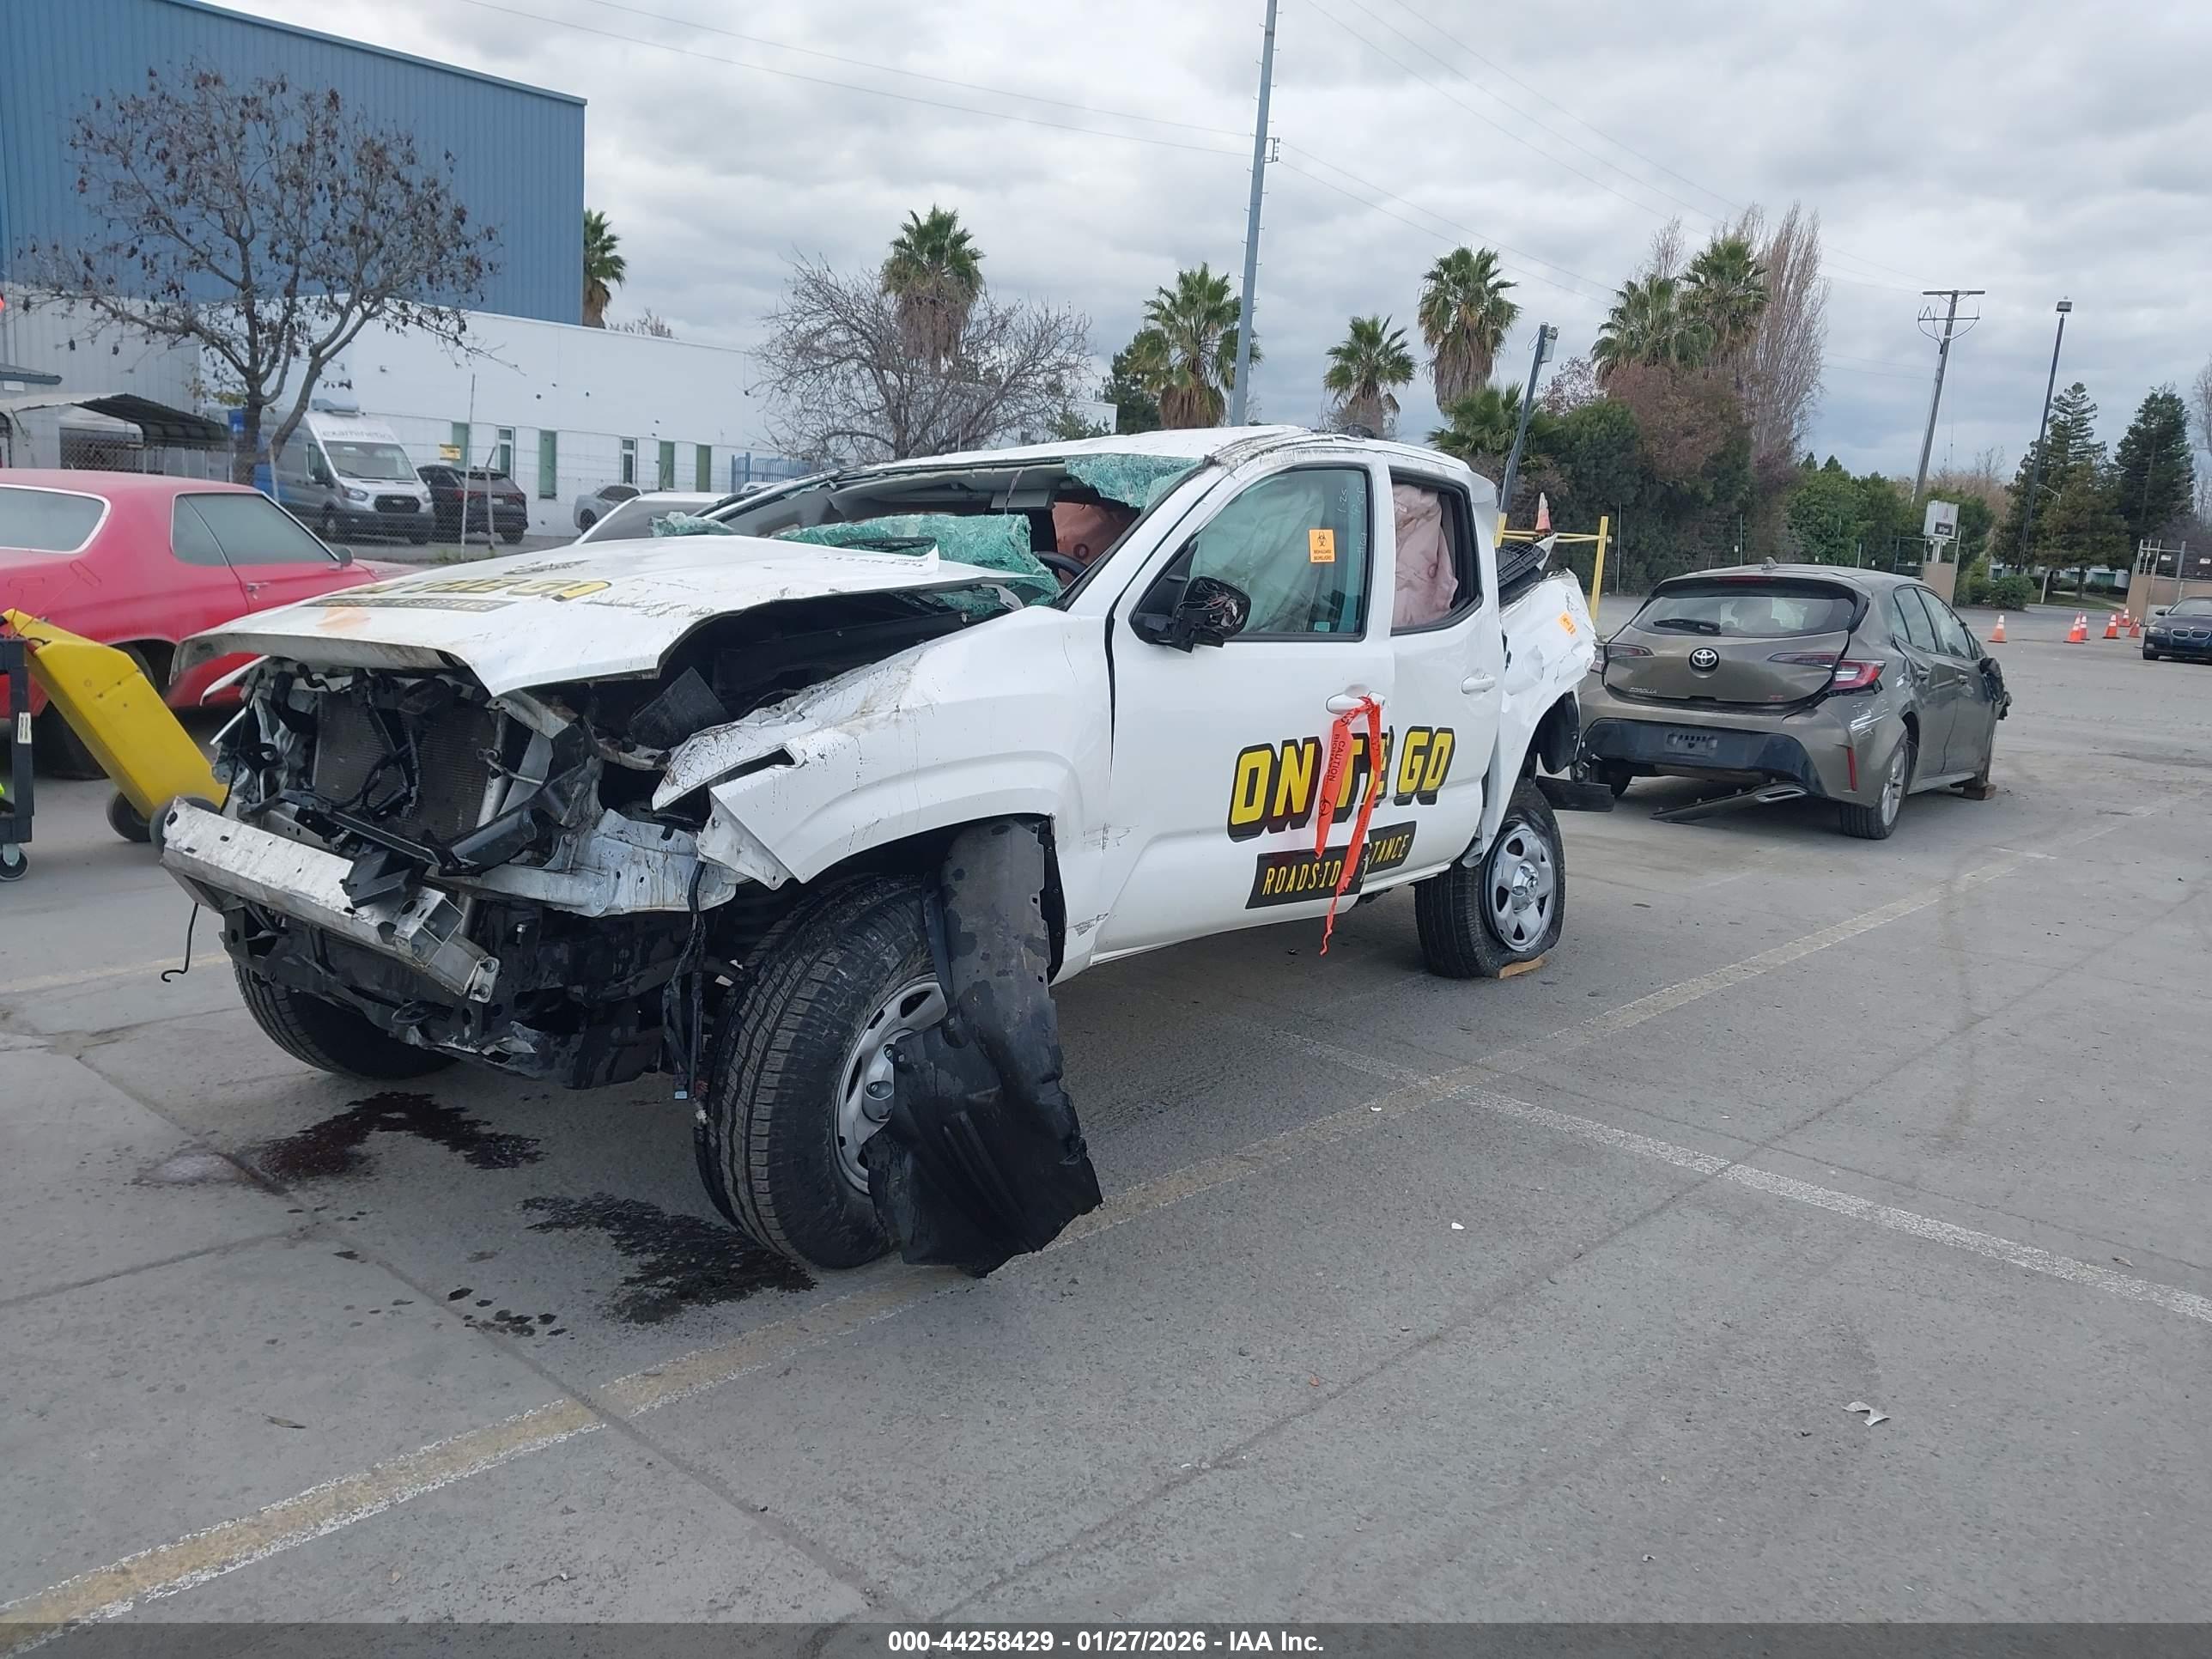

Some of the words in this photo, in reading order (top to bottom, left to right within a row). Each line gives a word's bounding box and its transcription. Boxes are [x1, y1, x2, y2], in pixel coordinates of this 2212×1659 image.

[1229, 738, 1322, 838] ON
[1395, 726, 1455, 805] GO
[1328, 740, 1346, 782] CAUTION
[1261, 860, 1342, 896] ROADSID
